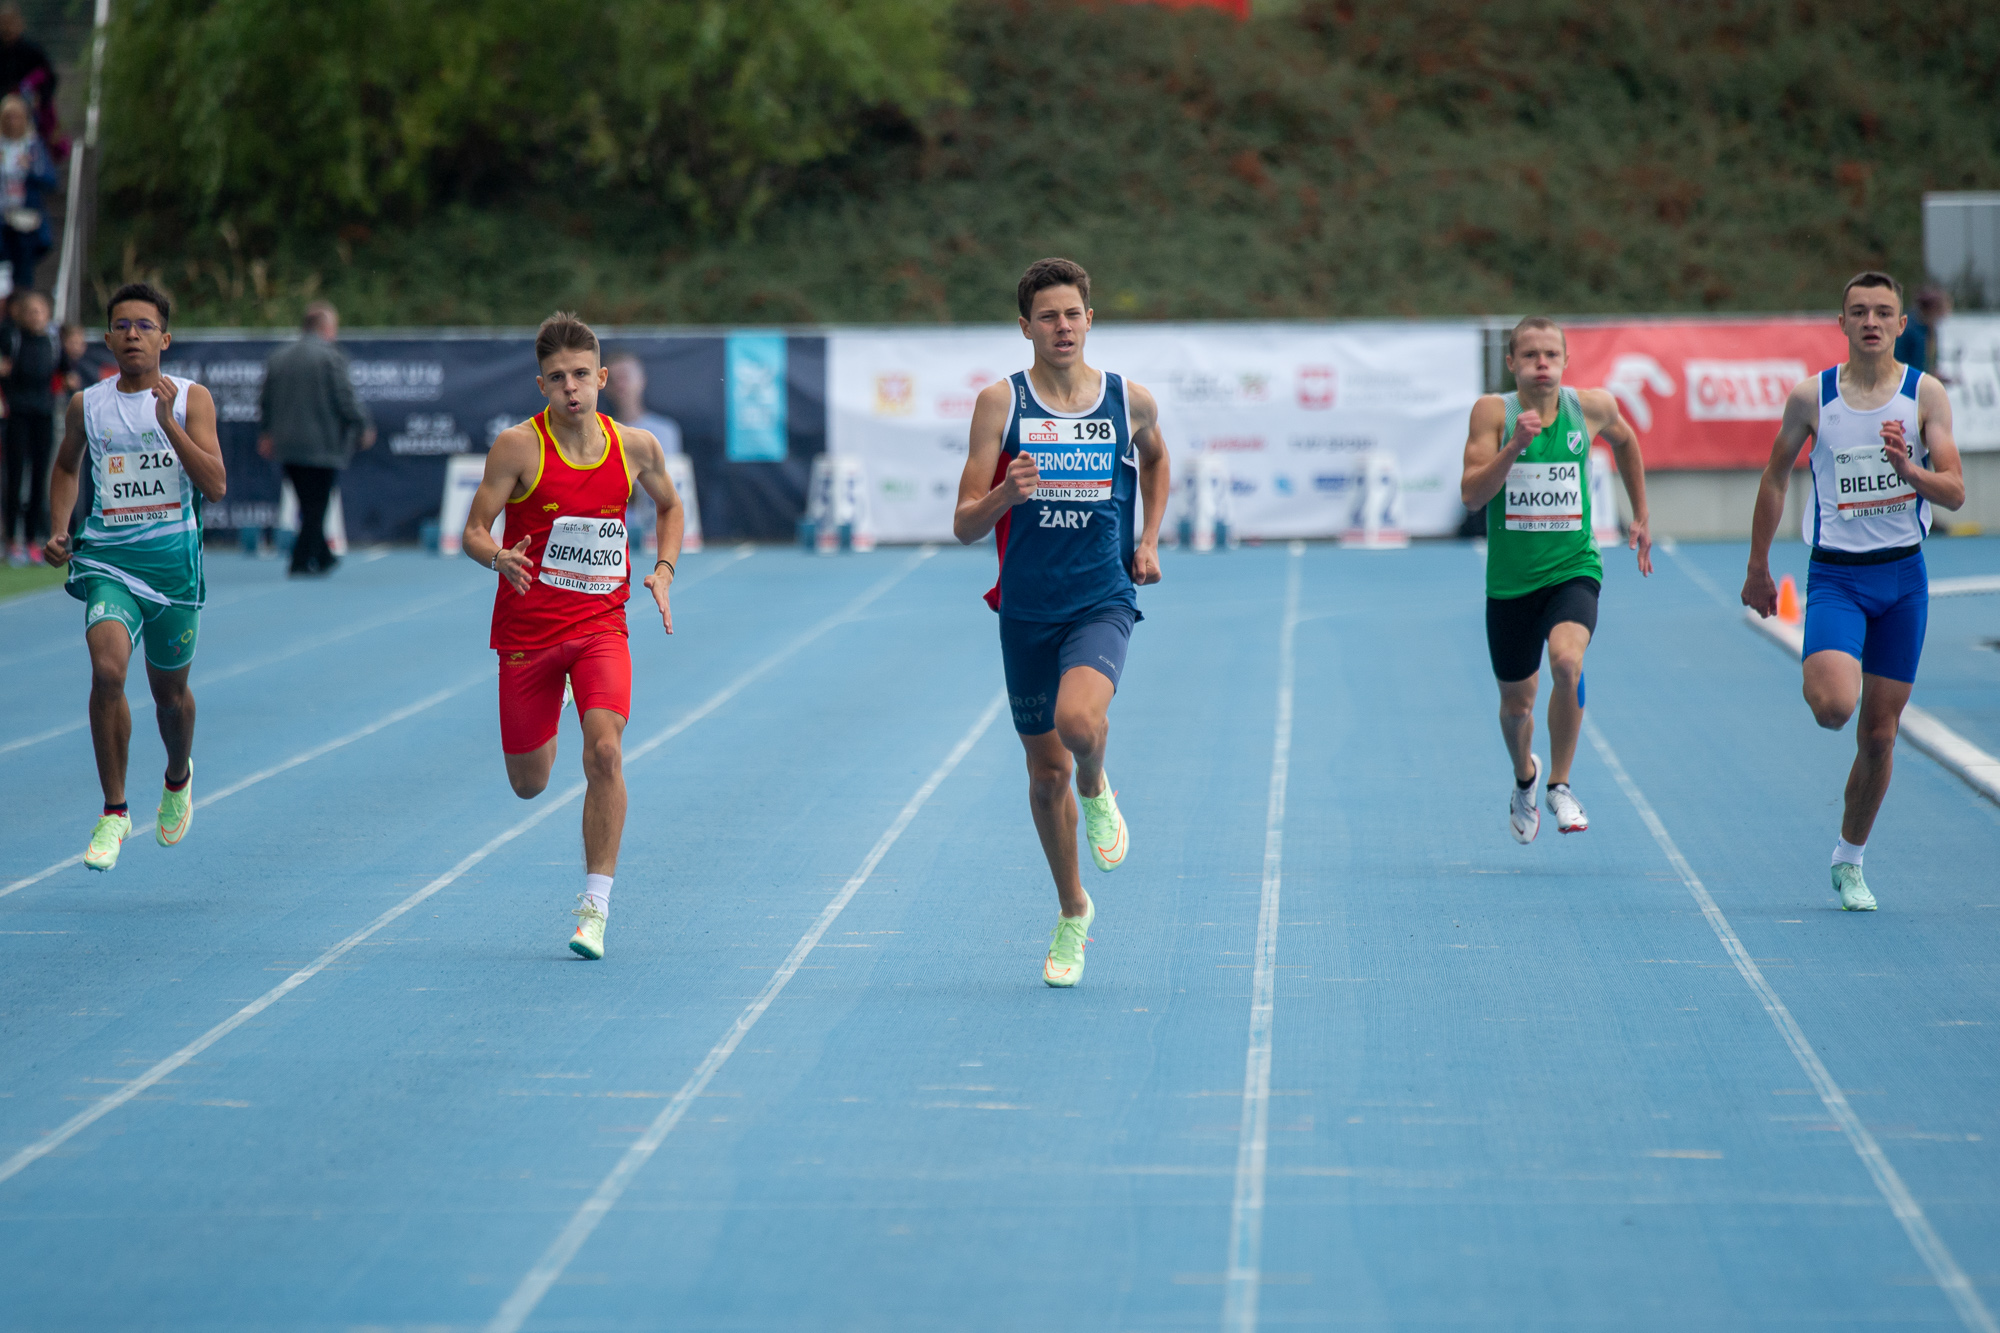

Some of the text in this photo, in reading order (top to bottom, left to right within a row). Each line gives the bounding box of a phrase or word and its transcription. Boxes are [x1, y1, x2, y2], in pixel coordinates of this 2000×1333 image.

[1029, 433, 1058, 441] ORLEN
[1073, 422, 1111, 440] 198
[139, 452, 173, 470] 216
[1030, 448, 1112, 471] IERNOŻYCKI
[1548, 466, 1576, 481] 504
[113, 480, 165, 498] STALA
[1840, 473, 1908, 494] BIELECK
[1036, 489, 1099, 498] LUBLIN 2022
[1509, 491, 1578, 506] ŁAKOMY
[114, 511, 168, 523] LUBLIN 2022
[1039, 505, 1093, 529] ŻARY
[1853, 506, 1884, 518] LUBLIN
[1887, 502, 1907, 513] 2022
[598, 522, 625, 538] 604
[1518, 521, 1570, 530] LUBLIN 2022
[548, 543, 622, 566] SIEMASZKO
[554, 576, 587, 590] LUBLIN
[588, 582, 612, 591] 2022
